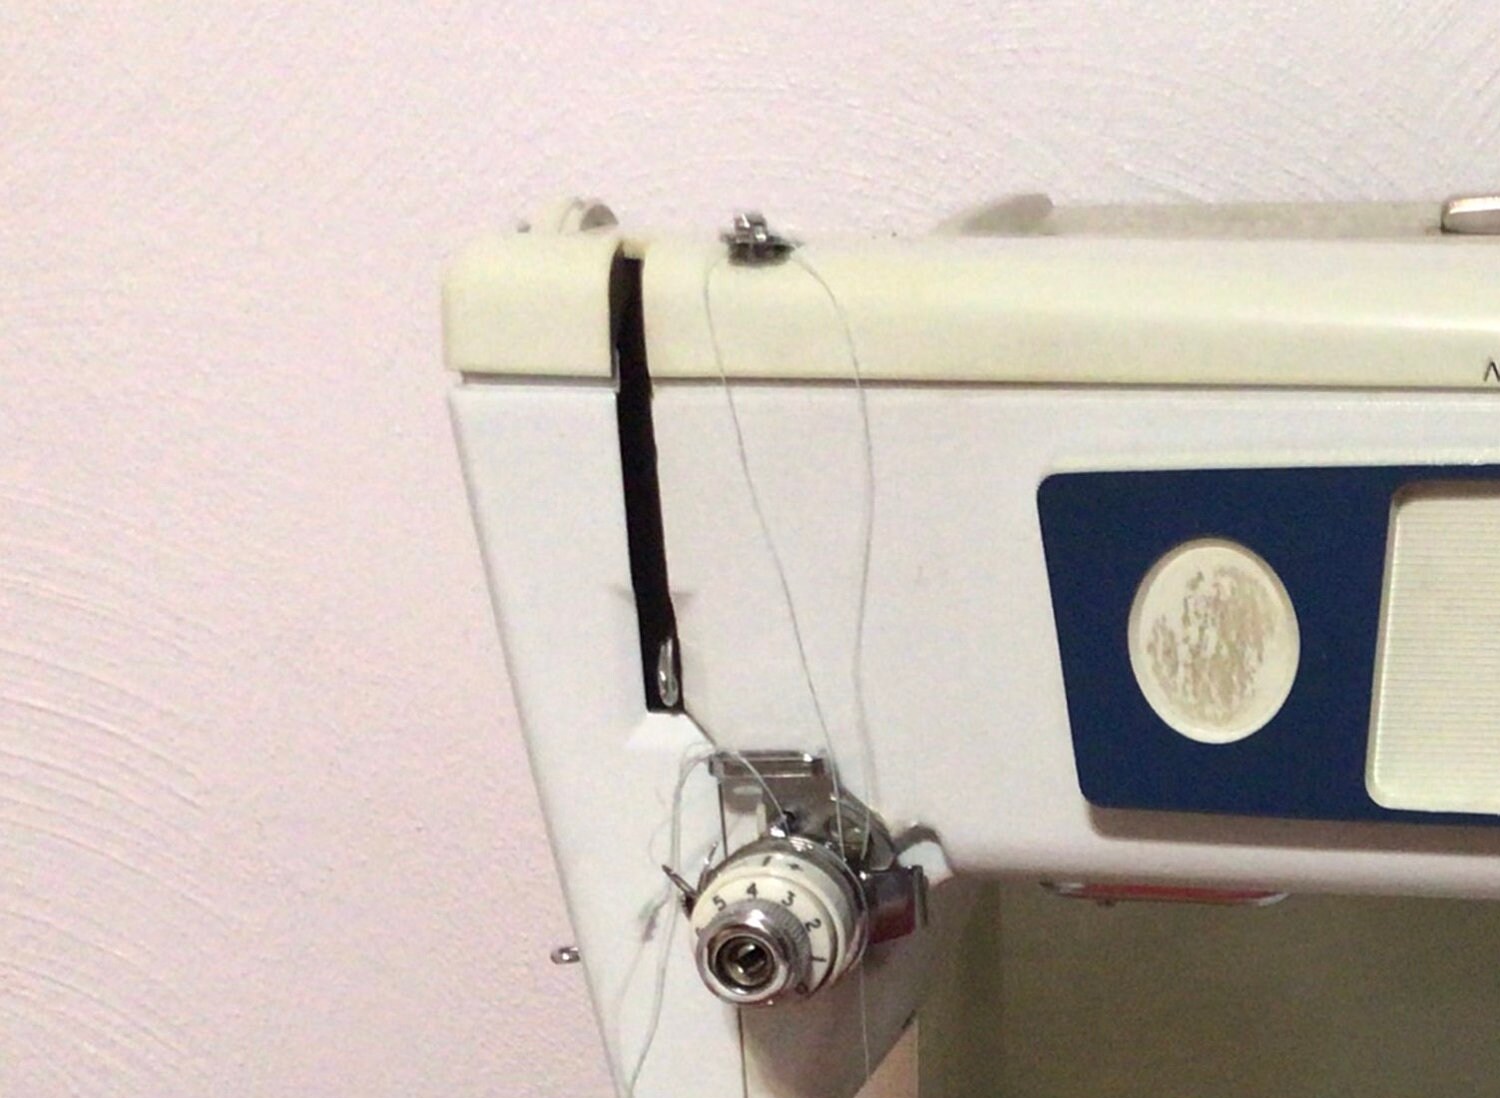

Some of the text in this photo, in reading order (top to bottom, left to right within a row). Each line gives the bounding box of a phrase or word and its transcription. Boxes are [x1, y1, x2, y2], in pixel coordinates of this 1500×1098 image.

[746, 882, 759, 899] 4
[781, 890, 796, 907] 3
[712, 895, 727, 912] 5
[804, 917, 821, 933] 2
